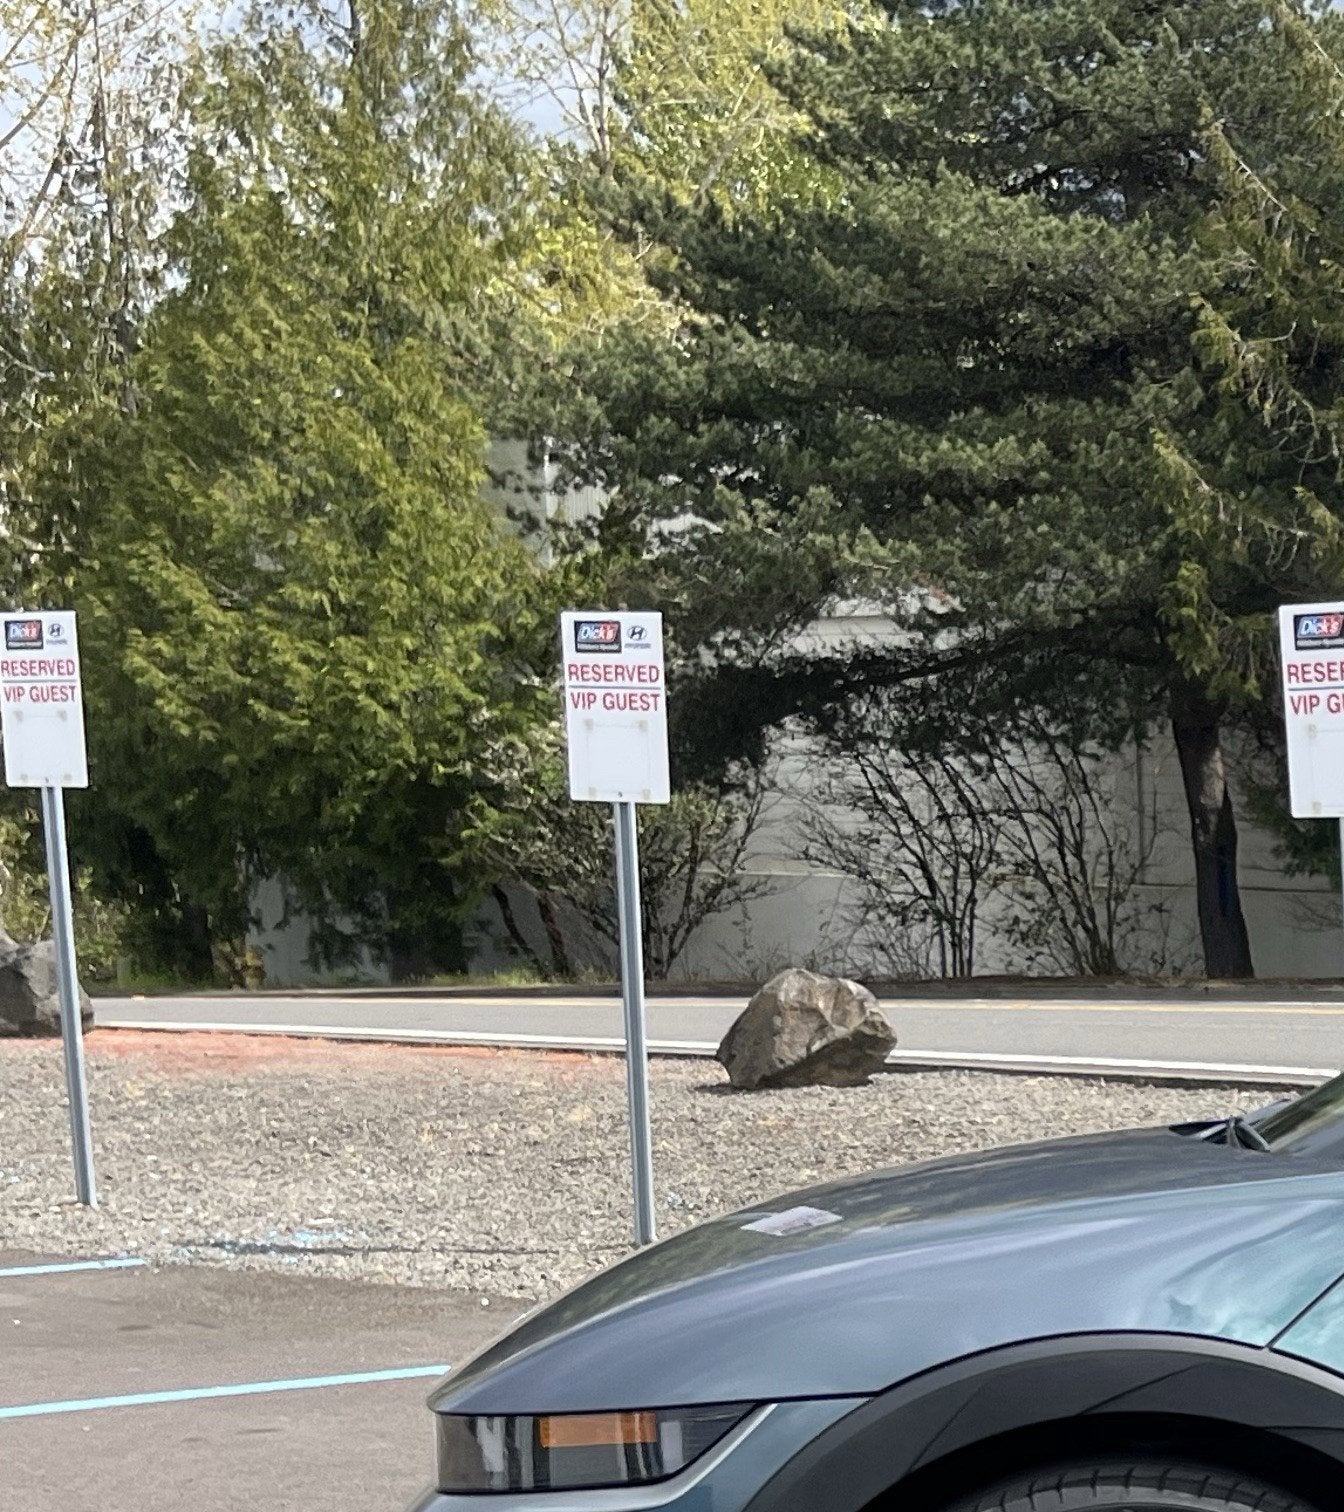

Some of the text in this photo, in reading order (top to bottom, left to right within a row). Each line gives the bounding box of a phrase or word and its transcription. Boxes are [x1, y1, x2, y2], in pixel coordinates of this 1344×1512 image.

[0, 659, 76, 677] RESERVED
[567, 663, 660, 683] RESERVED
[4, 685, 77, 702] VIP GUEST
[570, 692, 660, 711] VIP GUEST
[1290, 694, 1320, 715] VIP
